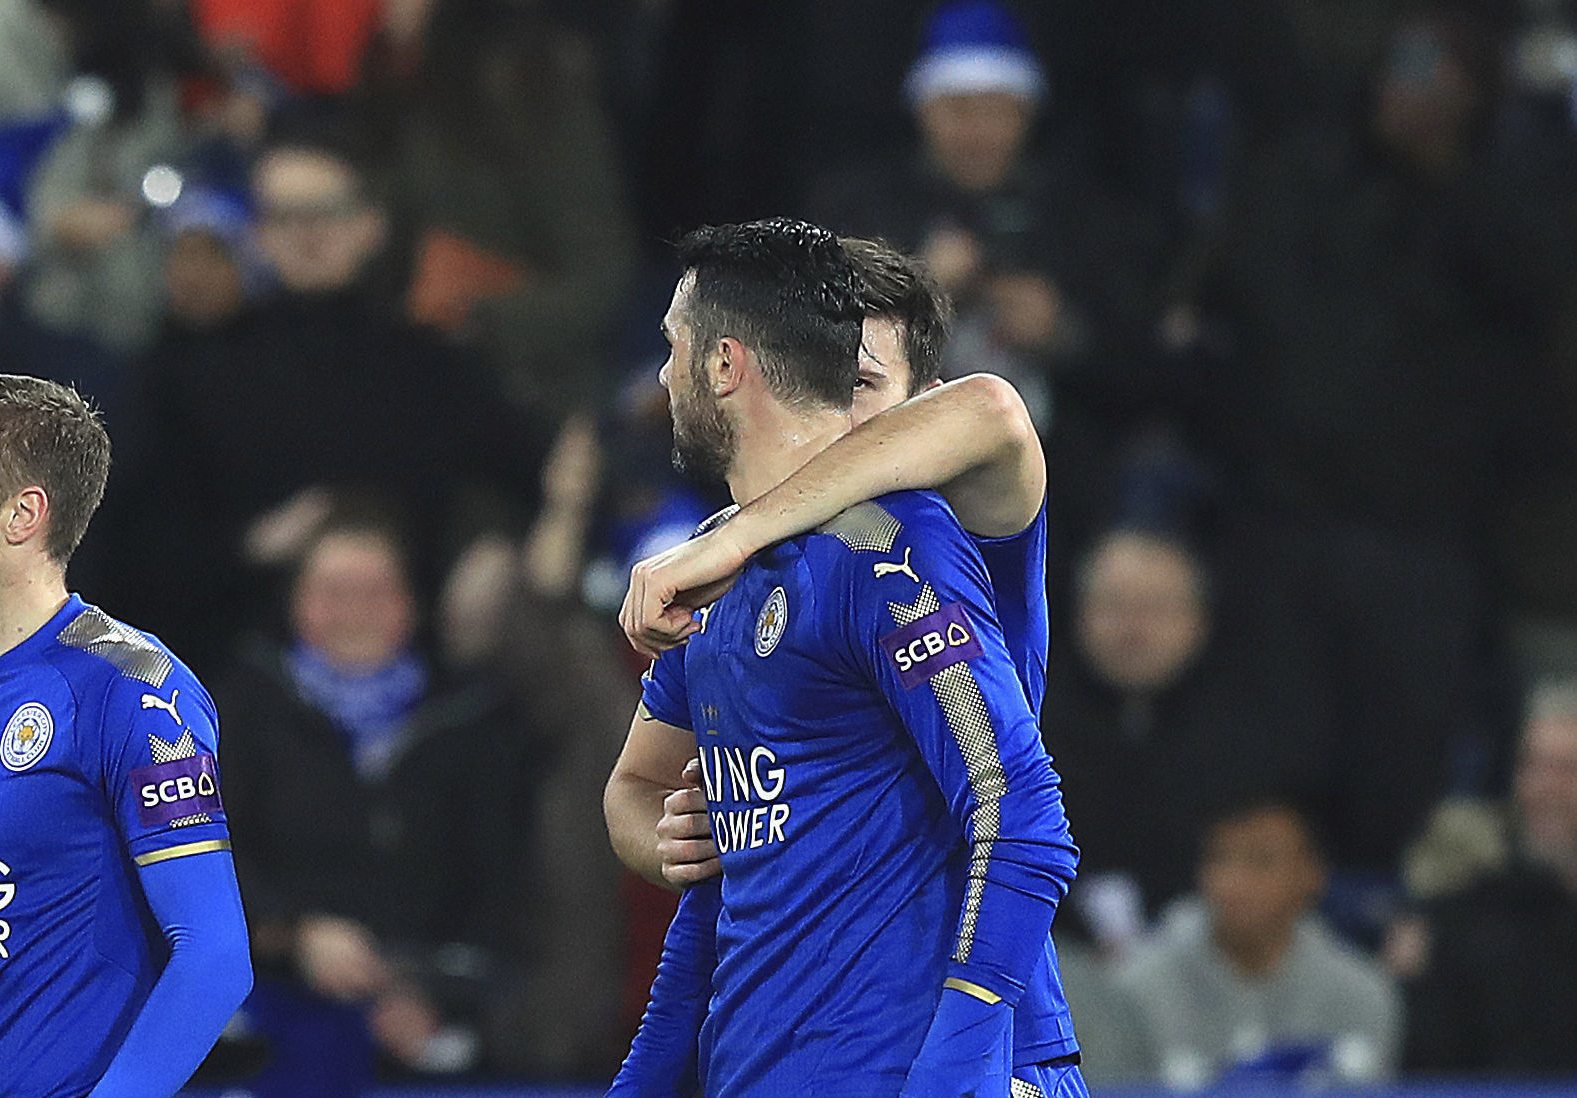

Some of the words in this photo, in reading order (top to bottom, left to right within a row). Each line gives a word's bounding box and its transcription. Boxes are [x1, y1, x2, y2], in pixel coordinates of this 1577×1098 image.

[894, 631, 946, 672] SCB
[141, 776, 196, 807] SCB
[711, 803, 791, 854] OWER
